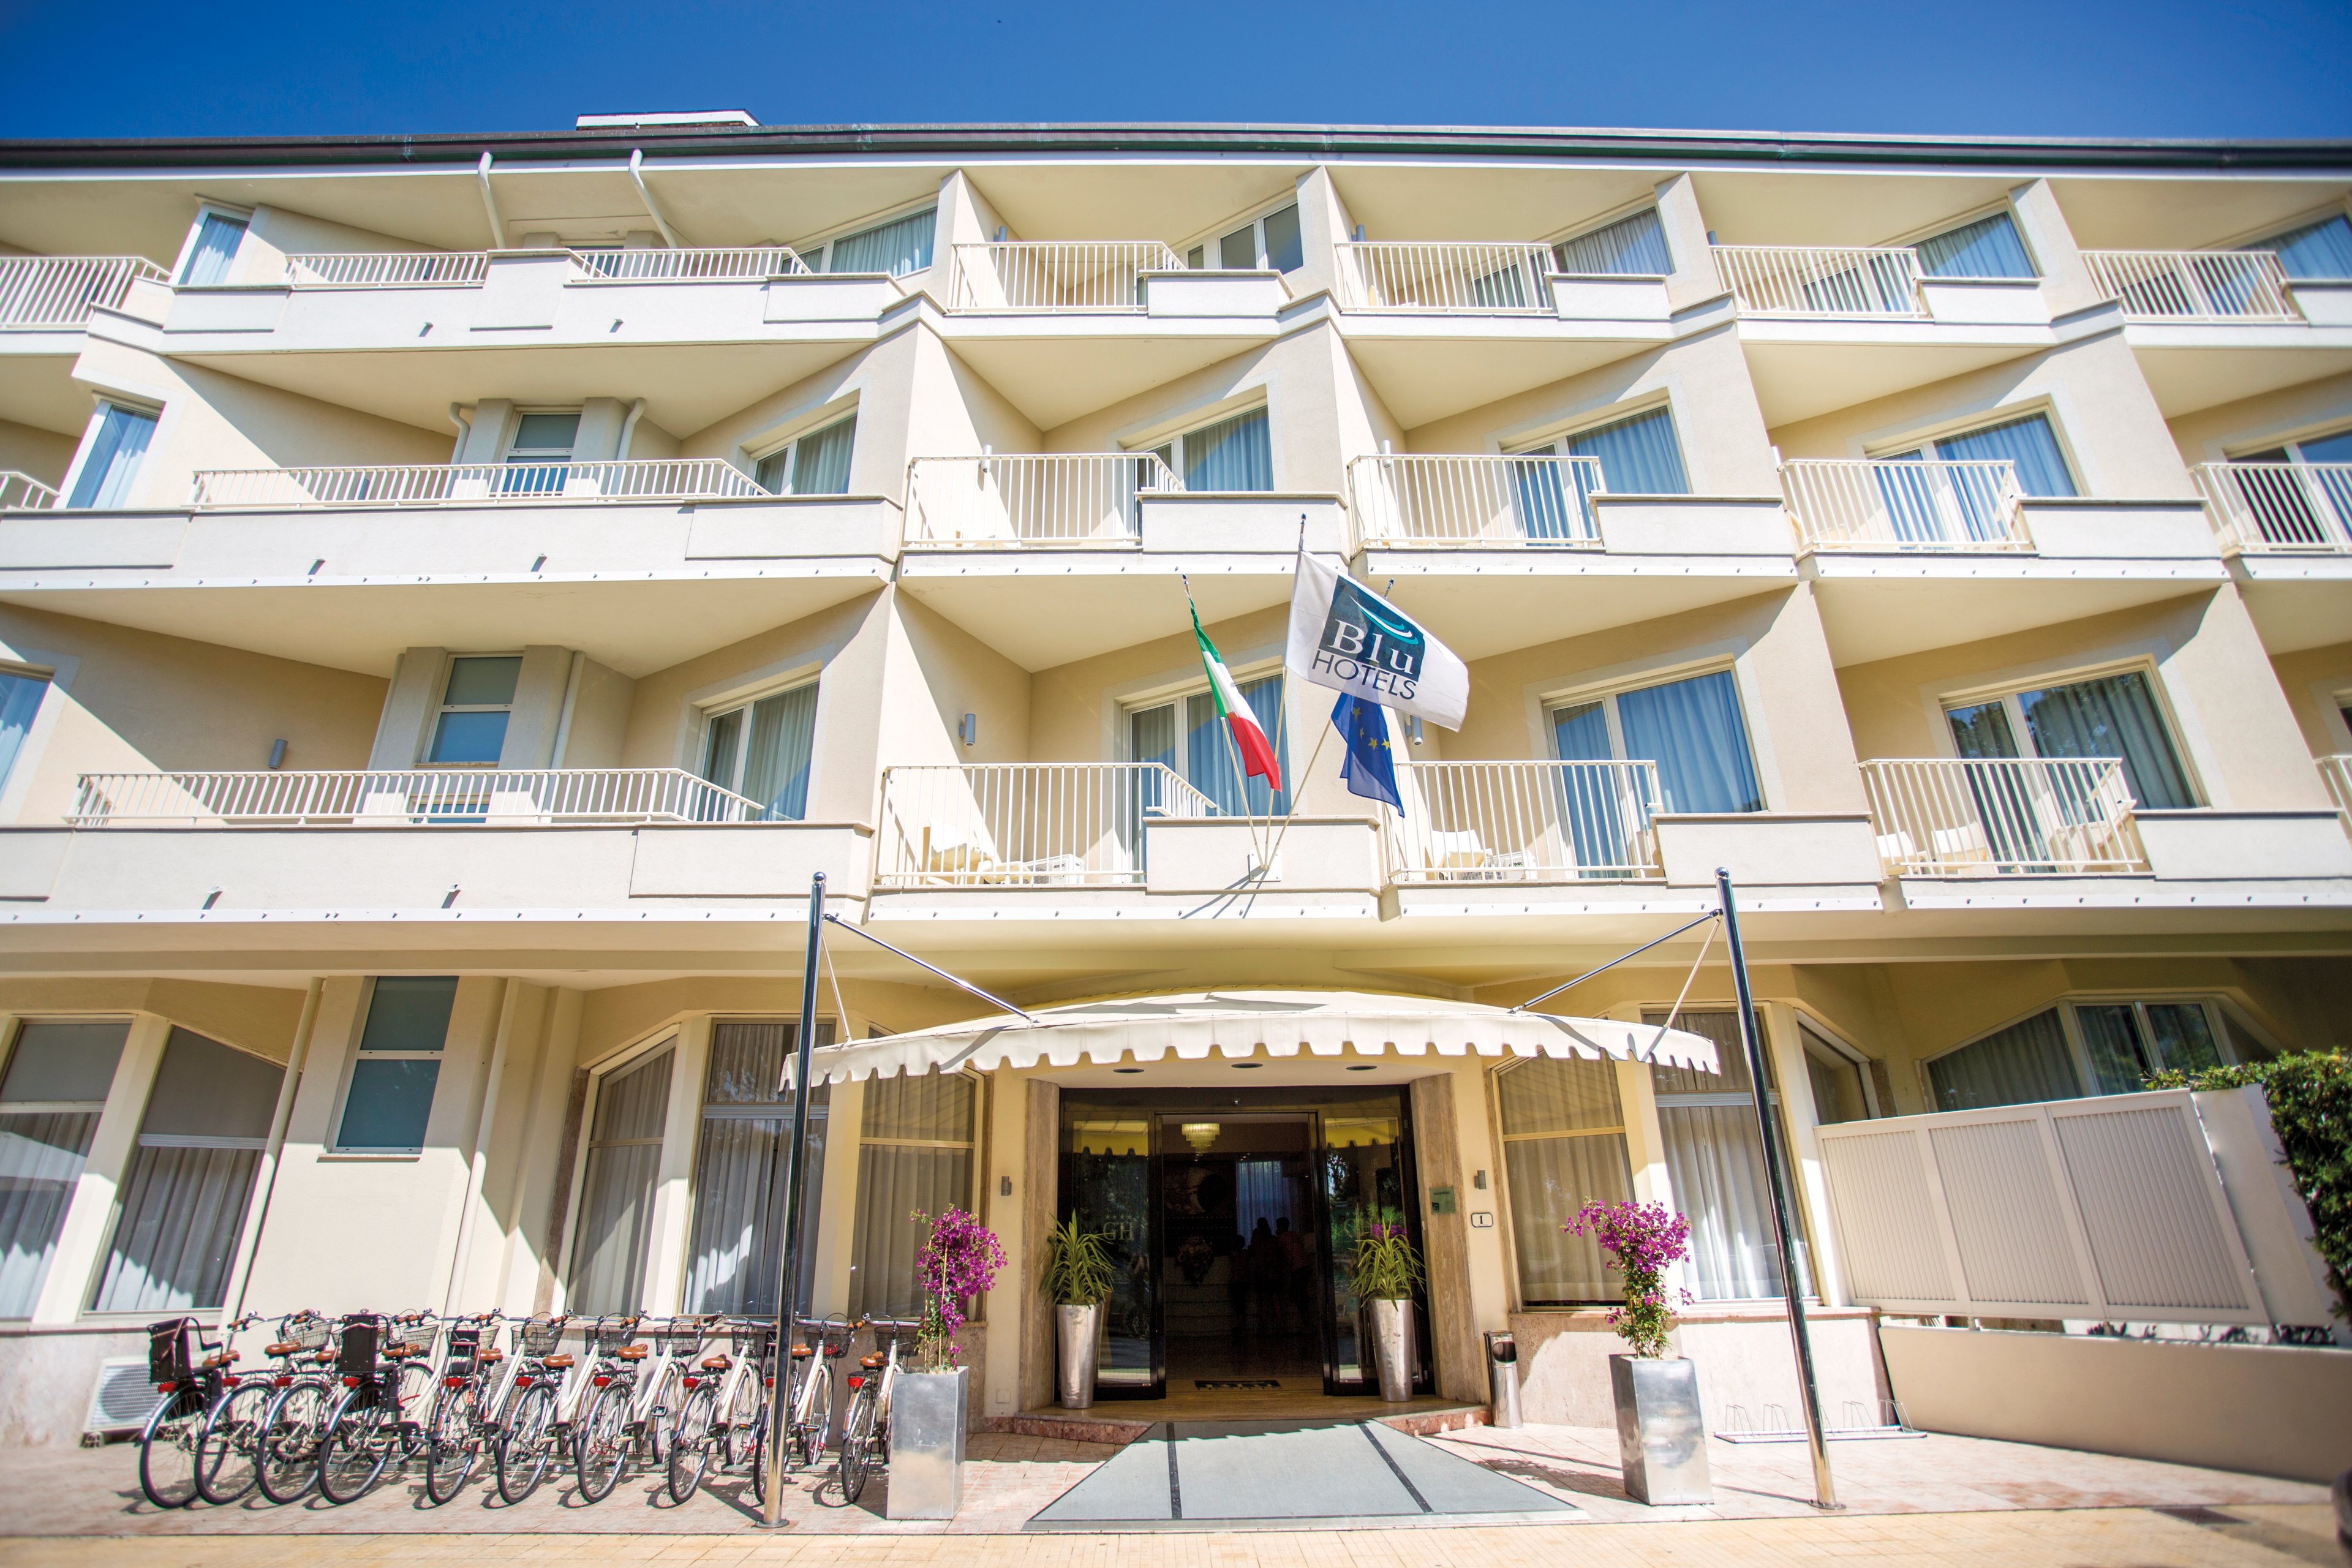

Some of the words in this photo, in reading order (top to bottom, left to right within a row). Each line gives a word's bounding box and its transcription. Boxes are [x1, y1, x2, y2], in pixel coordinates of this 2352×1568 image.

[1327, 619, 1414, 674] Blu
[1312, 650, 1417, 700] HOTELS
[1102, 1222, 1134, 1241] GH
[1479, 1215, 1483, 1224] 1
